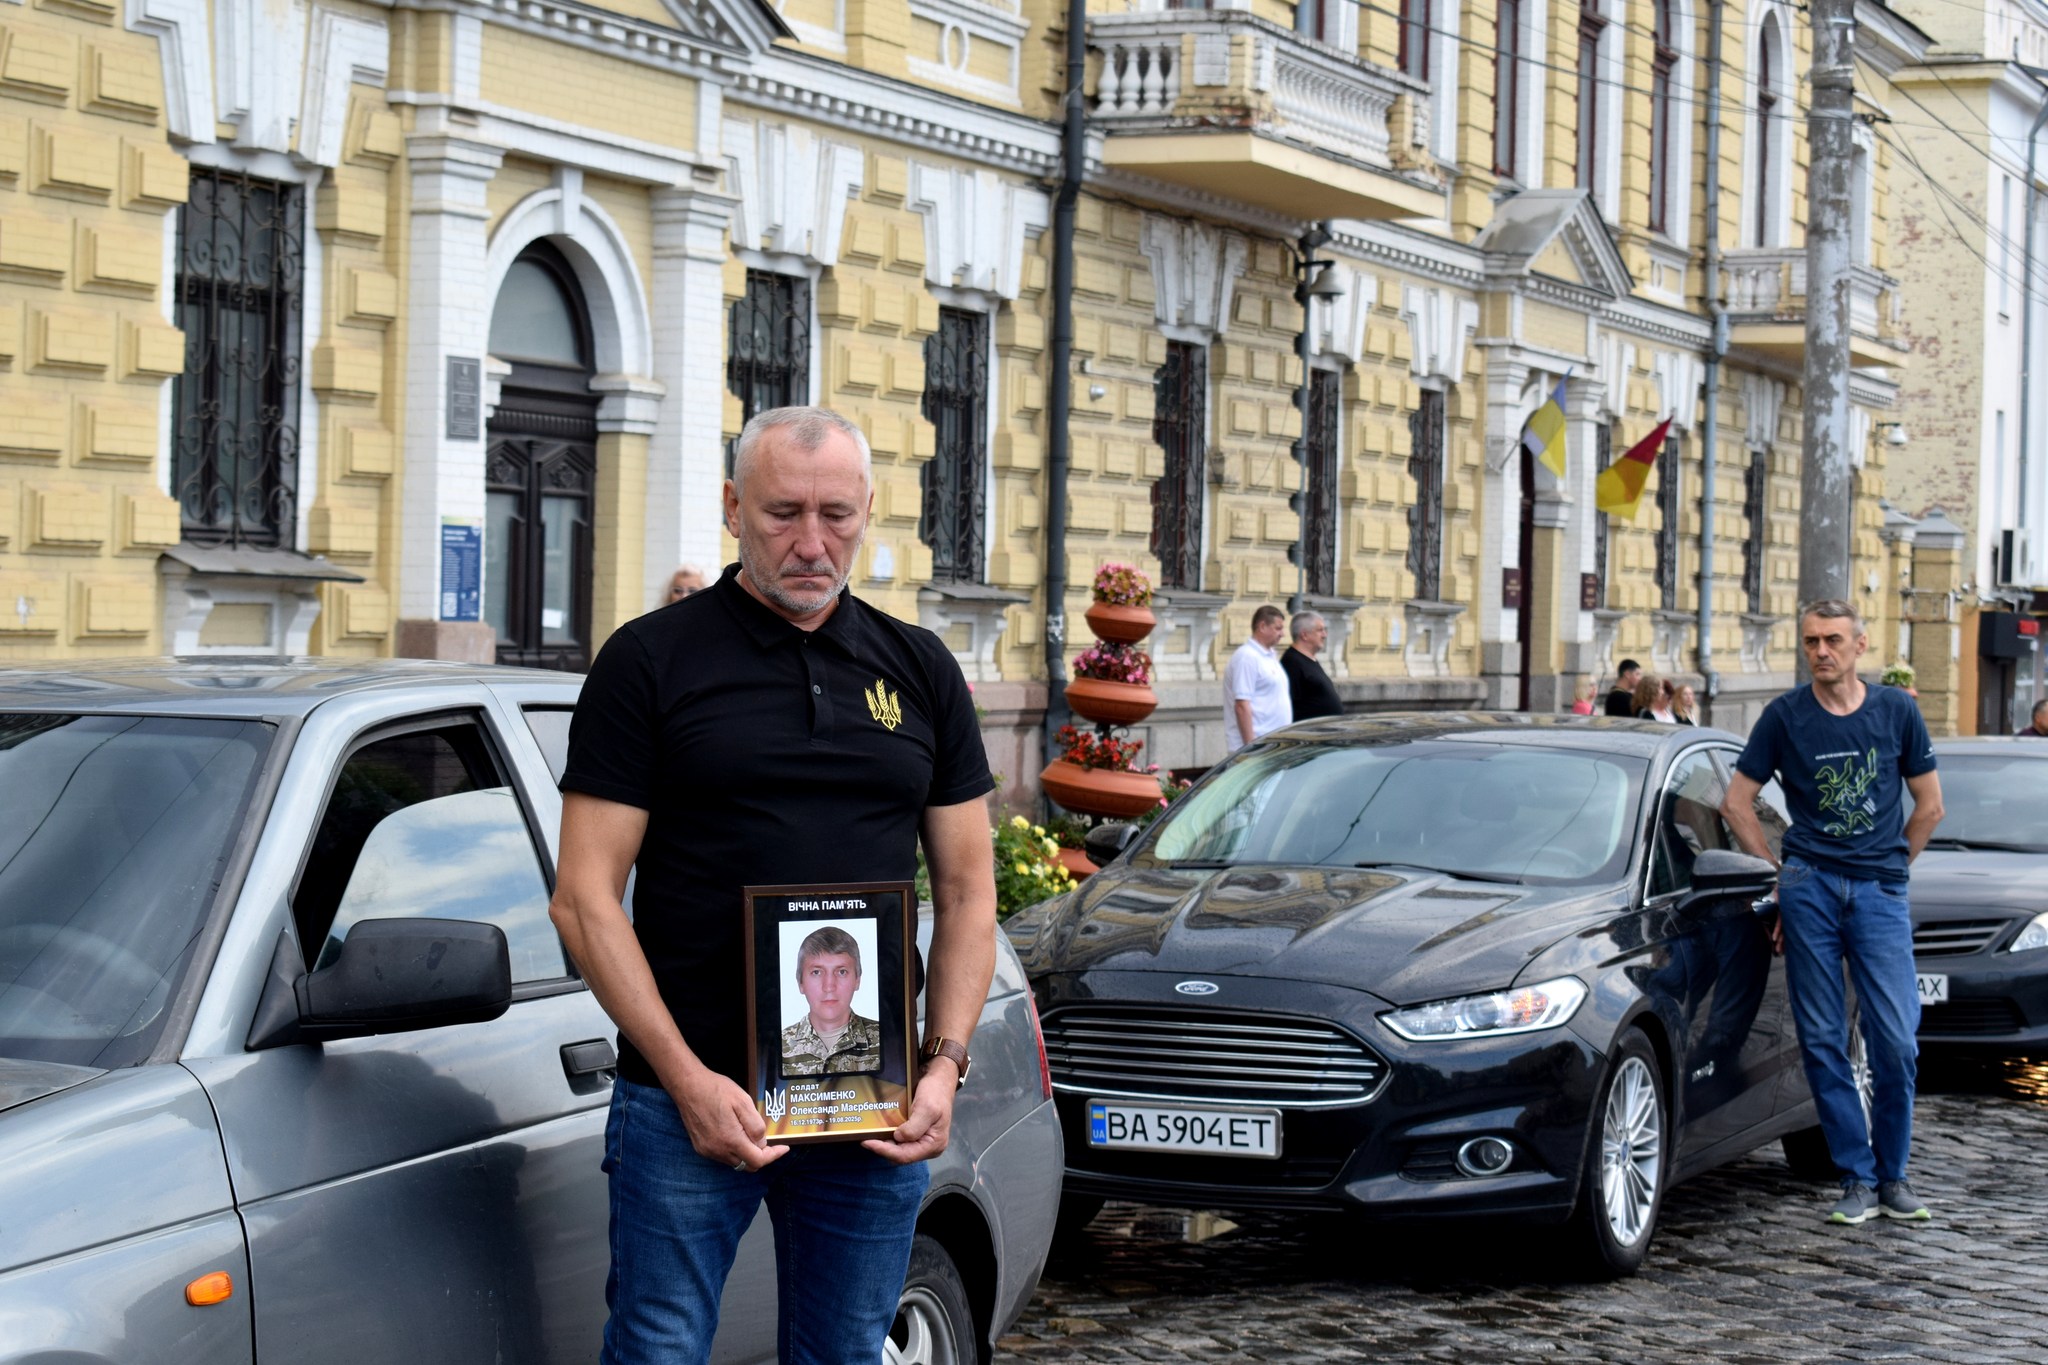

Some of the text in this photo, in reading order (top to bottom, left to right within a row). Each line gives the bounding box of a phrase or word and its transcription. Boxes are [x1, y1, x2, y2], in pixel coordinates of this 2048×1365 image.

[788, 900, 867, 911] ВІЧНА ПАМ'ЯТЬ
[790, 1083, 820, 1091] солдат
[790, 1090, 856, 1103] МАКСИМЕНКО
[790, 1101, 899, 1115] Олександр Маєрбекович
[1092, 1129, 1106, 1140] UA
[1107, 1112, 1272, 1148] BA 5904 ET
